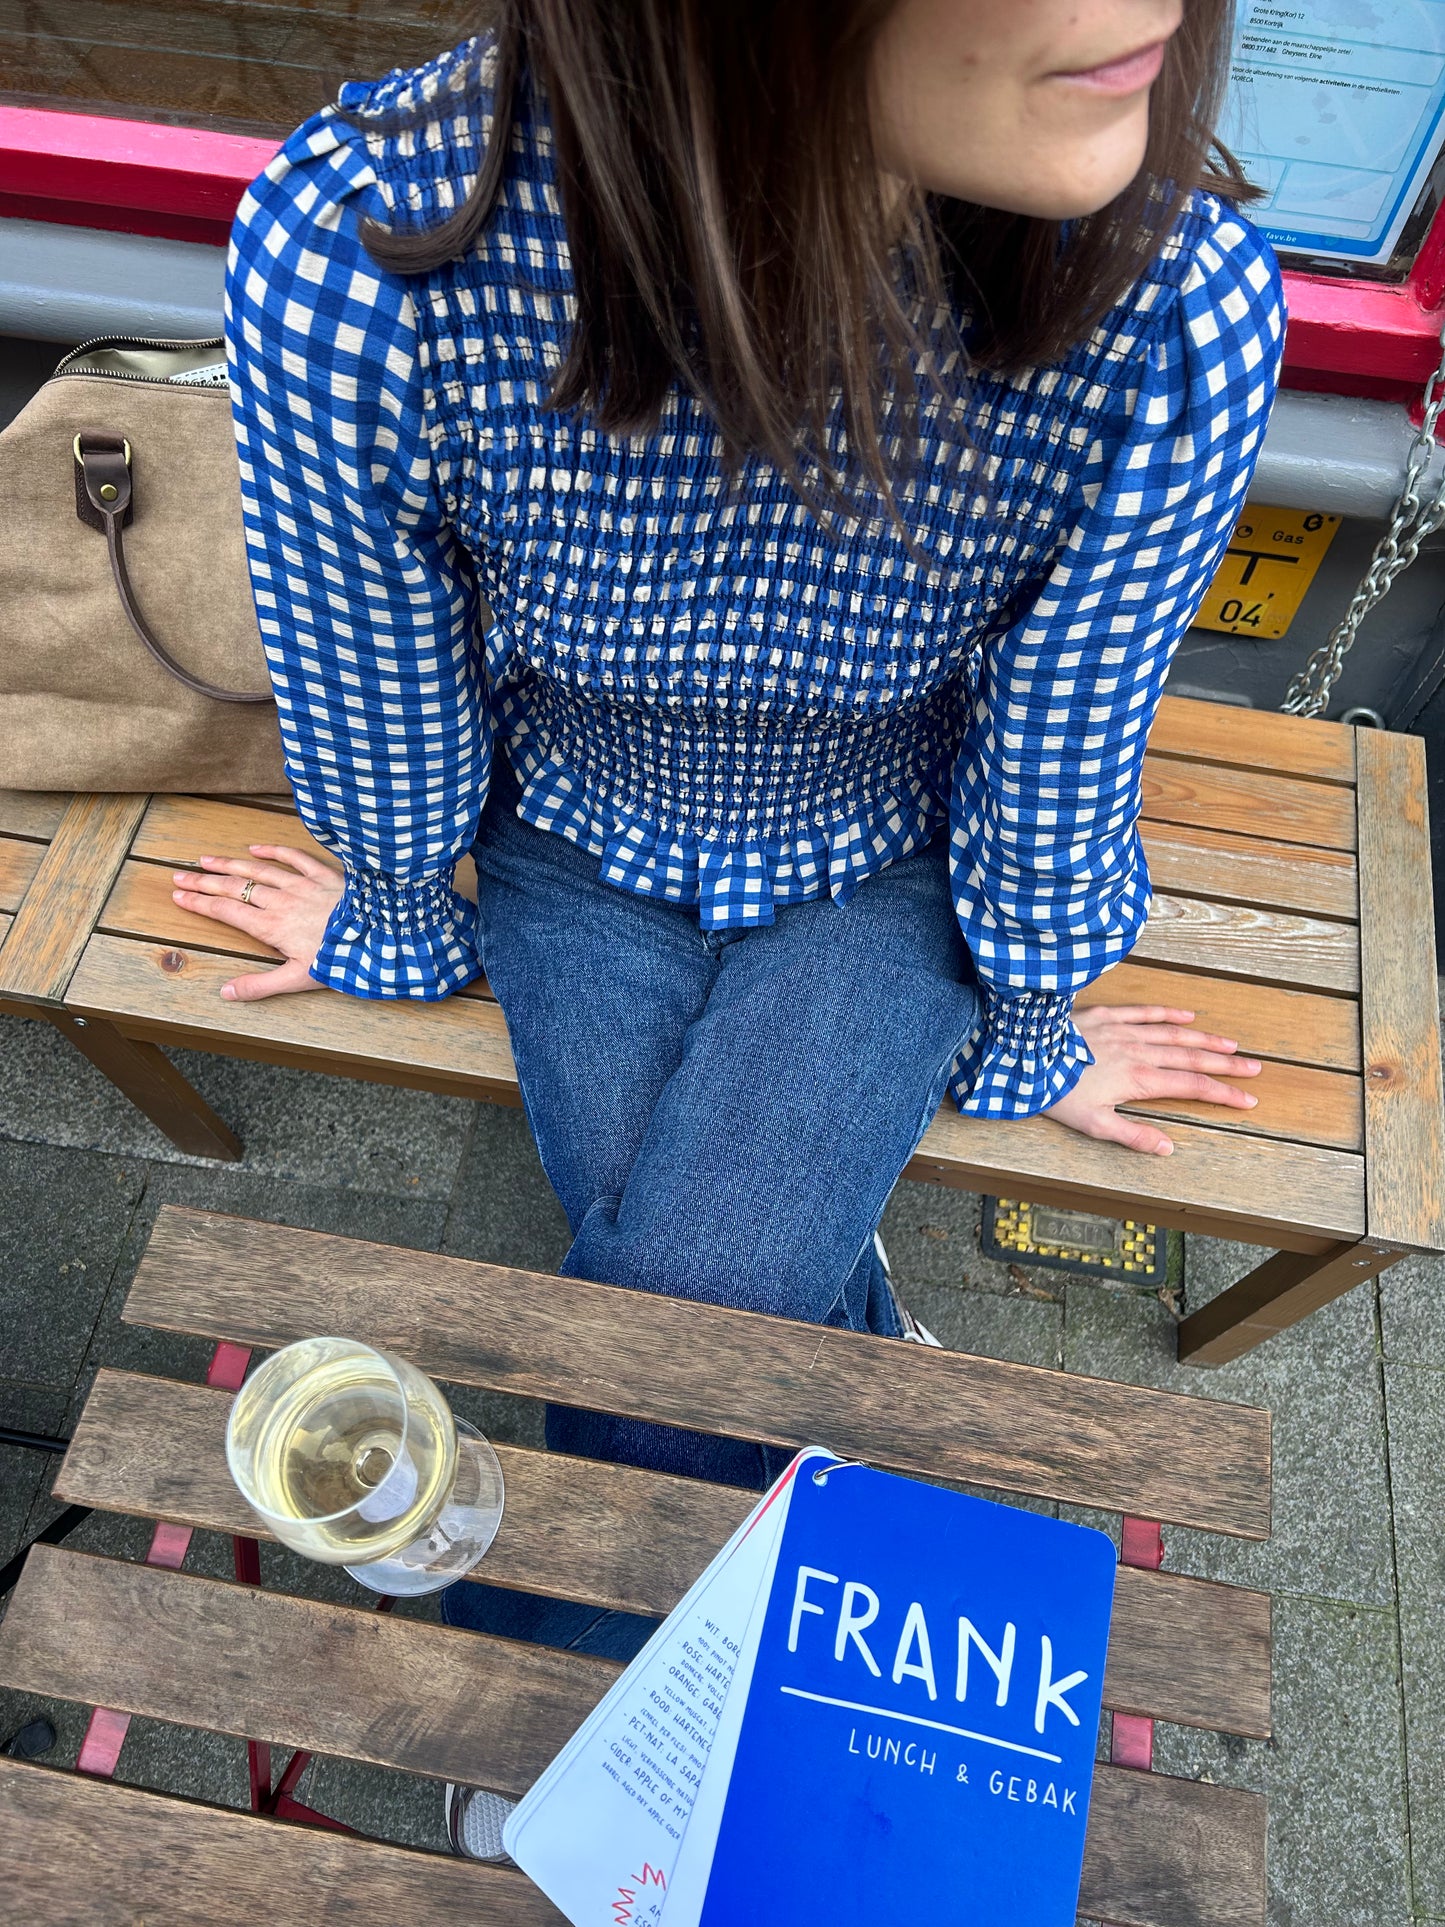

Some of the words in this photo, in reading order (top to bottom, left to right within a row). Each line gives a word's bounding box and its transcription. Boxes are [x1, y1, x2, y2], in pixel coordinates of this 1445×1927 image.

[1253, 6, 1269, 14] Grote
[1298, 12, 1305, 20] 12
[1264, 20, 1283, 28] Kortrijk
[1231, 75, 1254, 83] HORECA
[1319, 79, 1351, 88] activiteiten
[1266, 231, 1297, 243] favv.be
[1272, 530, 1304, 545] Gas
[710, 1650, 727, 1666] PINOT
[787, 1565, 1088, 1734] FRANK
[705, 1663, 731, 1689] HARTE
[664, 1685, 686, 1706] YELLOW
[708, 1683, 724, 1702] VOLLE
[666, 1752, 678, 1766] LA
[680, 1765, 701, 1788] SAPA
[848, 1728, 938, 1777] LUNCH
[956, 1763, 970, 1785] &
[989, 1771, 1077, 1816] GEBAK
[602, 1761, 620, 1782] BARREL
[648, 1807, 664, 1826] APPLE
[634, 1767, 659, 1794] APPLE
[660, 1793, 673, 1805] OF
[673, 1805, 688, 1819] MY
